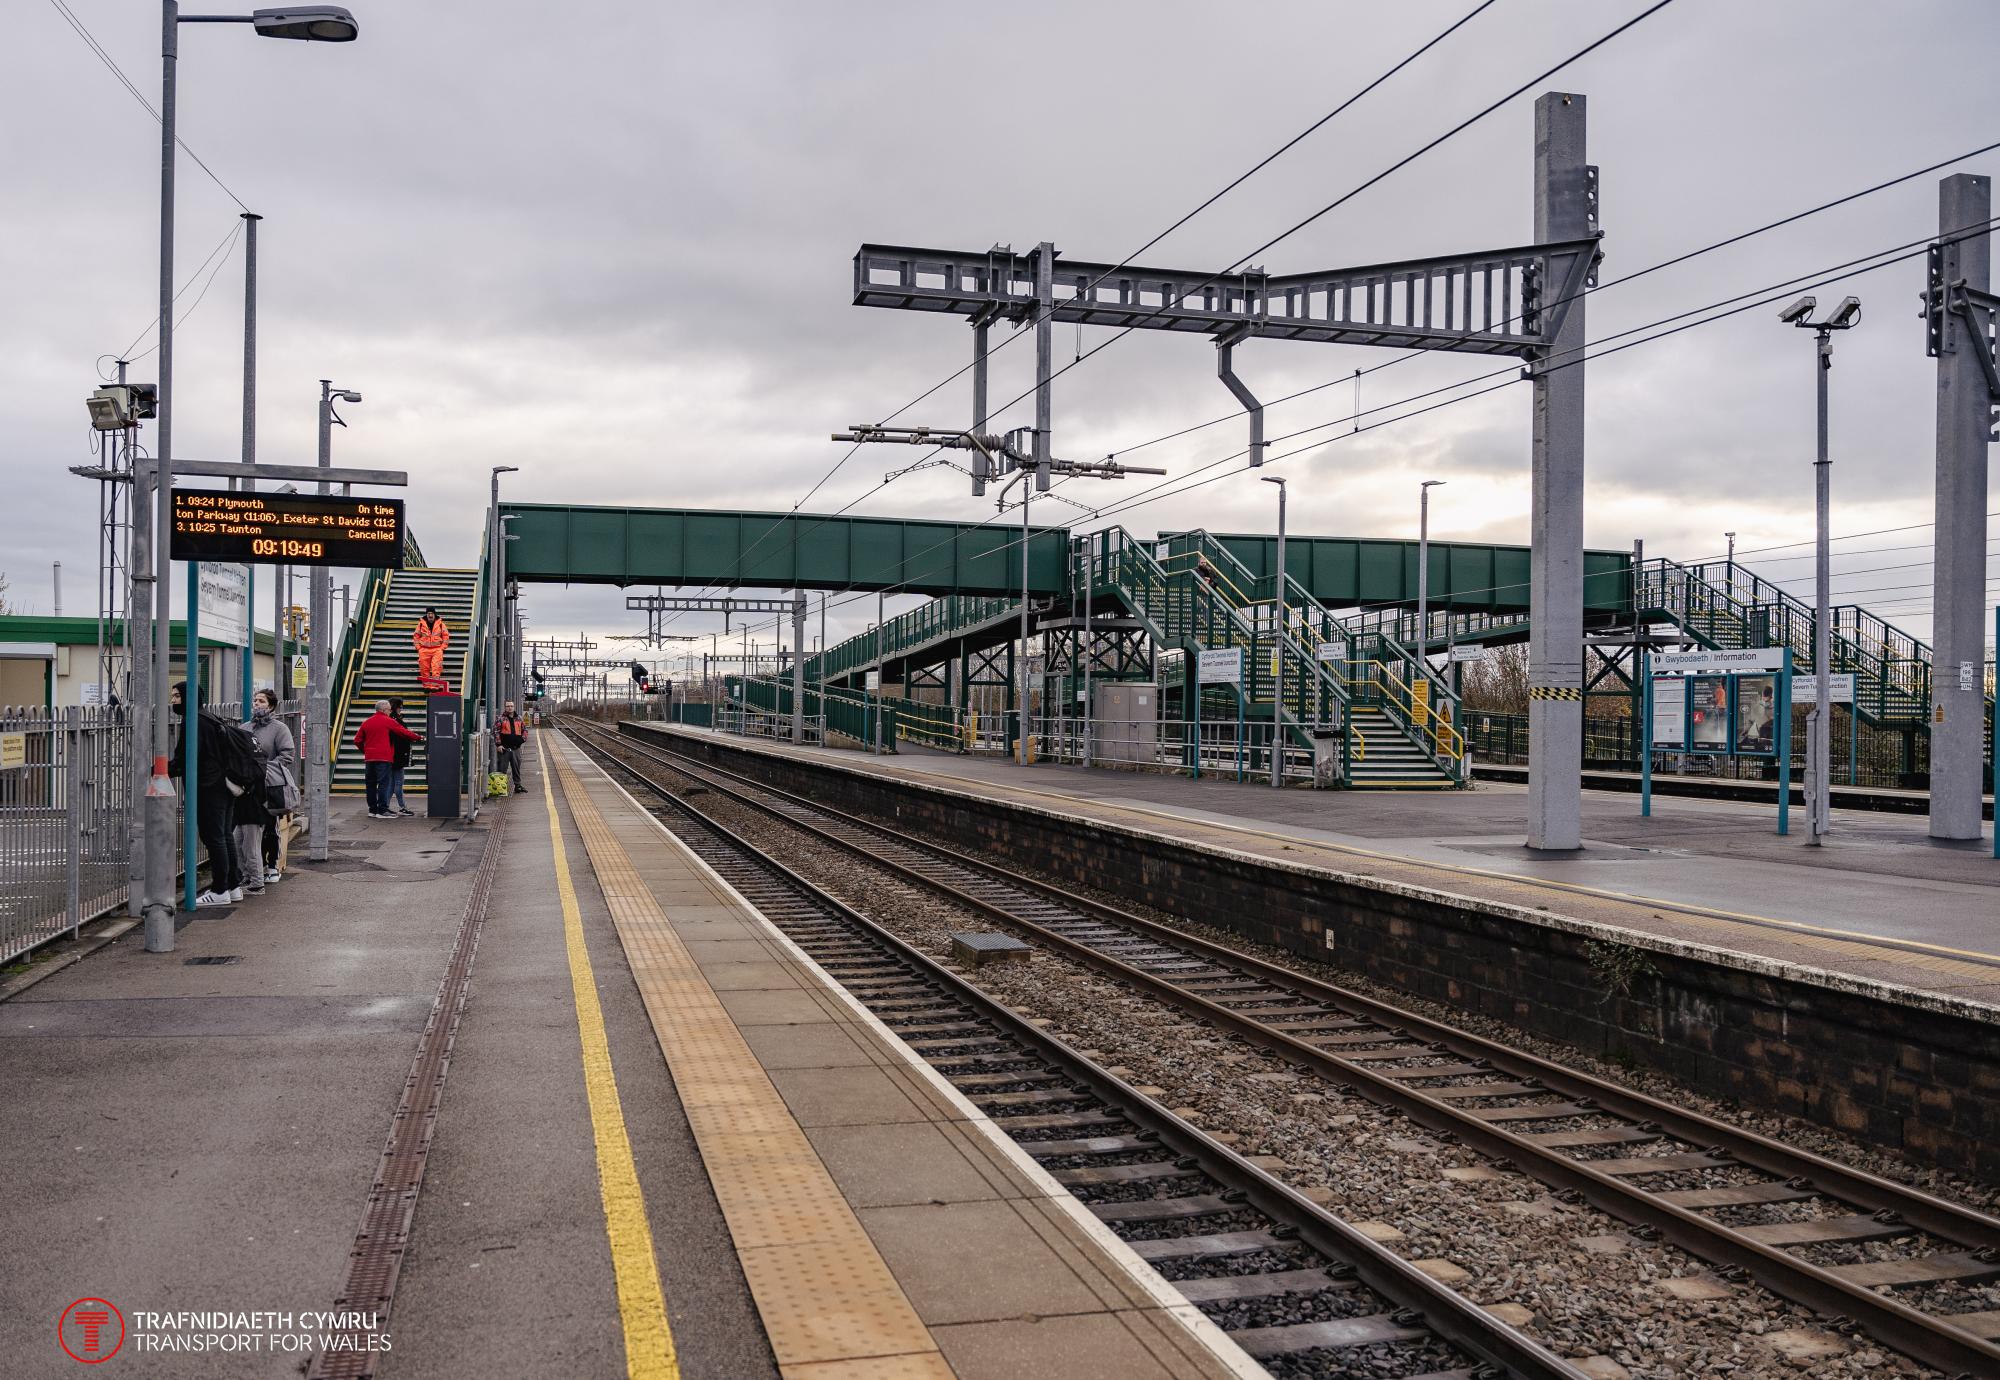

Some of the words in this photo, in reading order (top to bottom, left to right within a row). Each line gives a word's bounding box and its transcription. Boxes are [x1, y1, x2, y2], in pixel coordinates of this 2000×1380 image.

[176, 495, 184, 505] 1.
[218, 497, 264, 509] Plymouth
[358, 504, 370, 514] On
[374, 505, 395, 515] time
[176, 509, 194, 518] ton
[197, 509, 240, 522] Parkway
[283, 514, 319, 524] Exeter
[322, 516, 335, 525] St
[338, 516, 370, 526] Davids
[176, 522, 186, 531] 3.
[189, 523, 216, 532] 10:25
[220, 523, 262, 534] Taunton
[348, 530, 395, 540] Cancelled
[252, 539, 323, 557] 09:19:49
[1665, 655, 1709, 665] Gwybodaeth
[1714, 652, 1757, 662] Information
